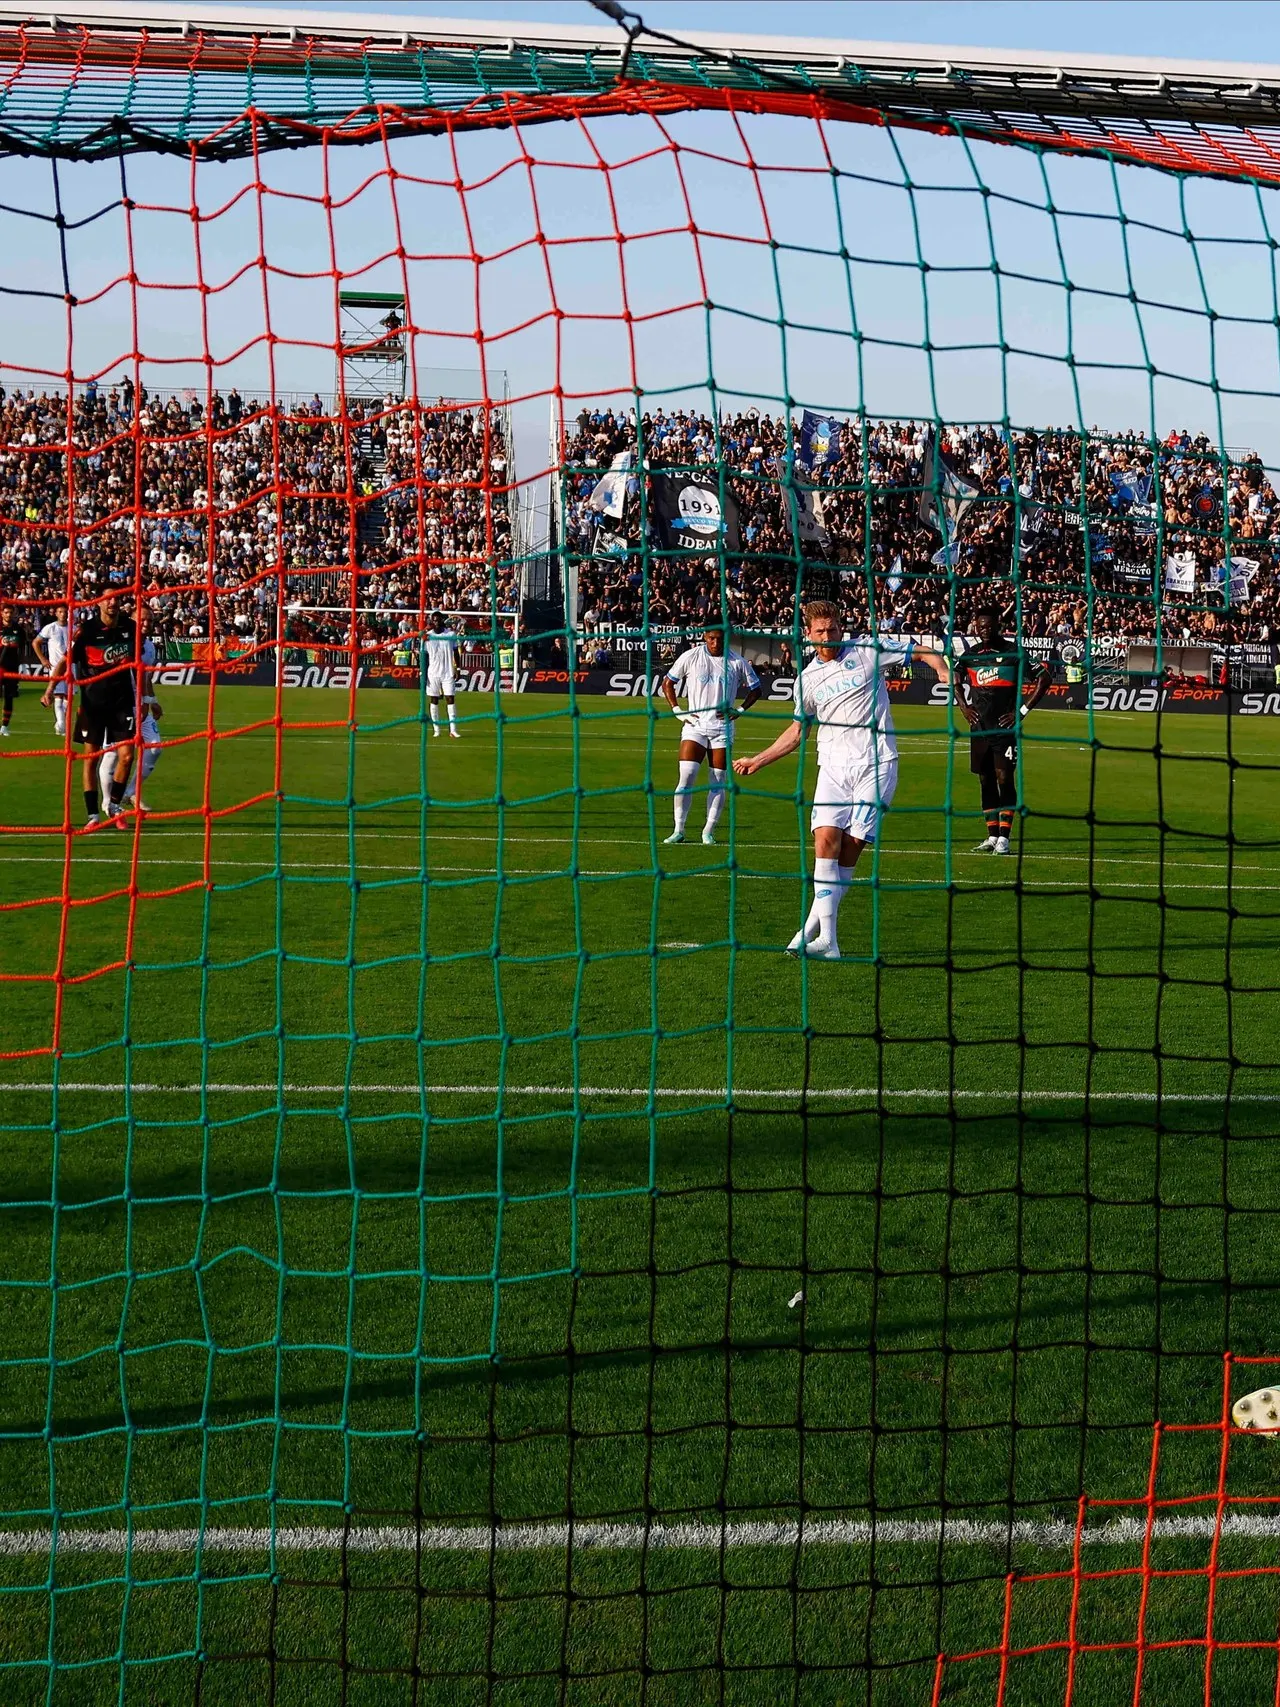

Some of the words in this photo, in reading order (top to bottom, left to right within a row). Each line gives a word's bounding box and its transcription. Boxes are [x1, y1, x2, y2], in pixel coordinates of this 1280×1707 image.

[680, 499, 720, 515] 1991
[1113, 564, 1151, 575] MERCATO
[616, 624, 641, 634] Are
[616, 638, 648, 651] Nord
[1027, 649, 1050, 661] APOLI
[976, 667, 999, 685] CYNAR
[827, 674, 863, 697] MSC
[126, 716, 133, 730] 7
